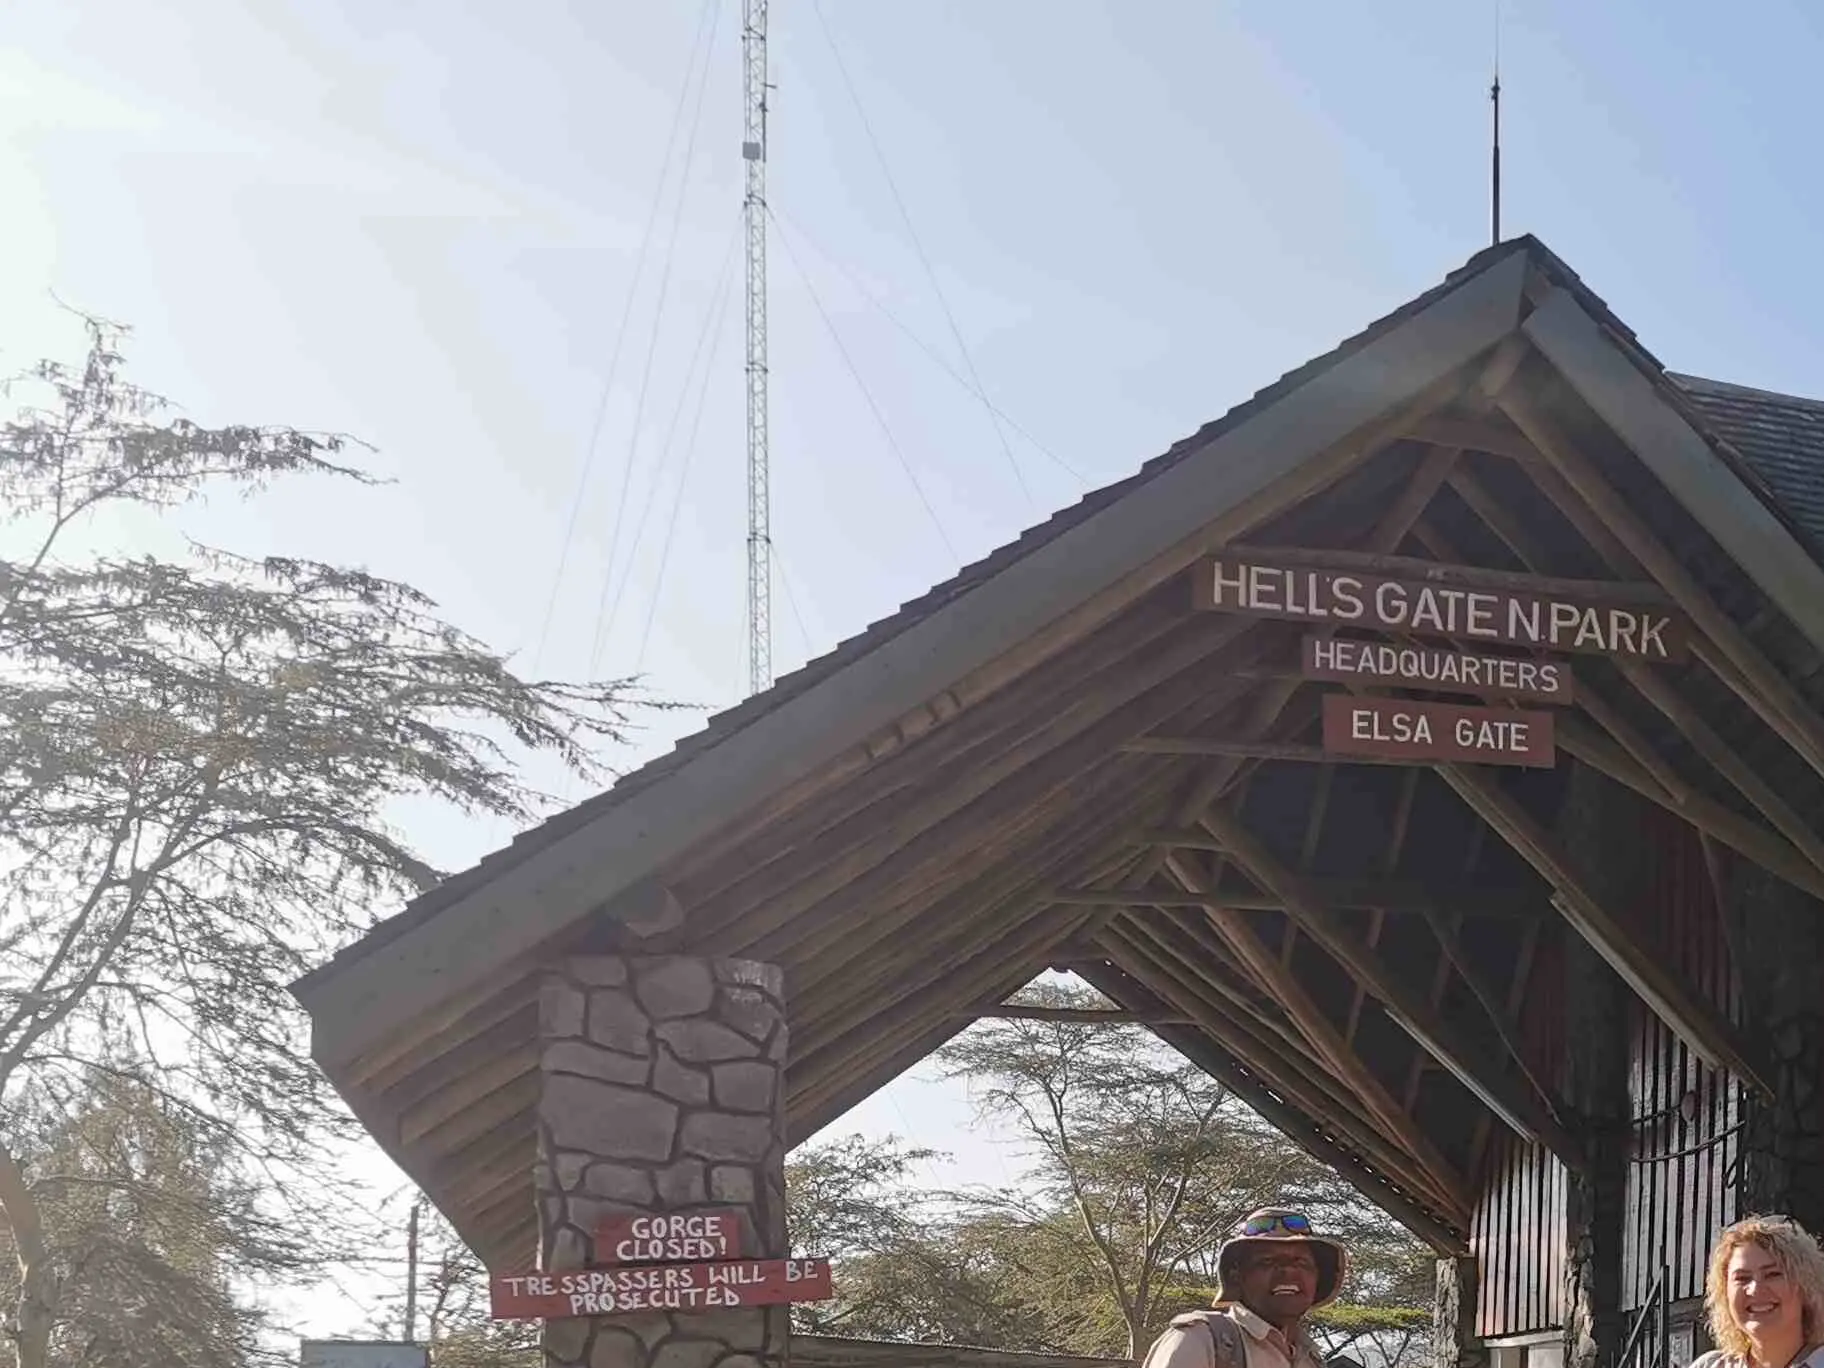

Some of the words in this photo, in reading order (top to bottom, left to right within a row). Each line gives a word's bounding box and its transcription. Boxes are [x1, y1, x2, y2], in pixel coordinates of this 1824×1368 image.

[1375, 581, 1499, 638] GATE
[1314, 640, 1560, 693] HEADQUARTERS
[1351, 709, 1433, 745] ELSA
[1454, 718, 1530, 752] GATE
[631, 1216, 722, 1238] GORGE
[616, 1236, 727, 1261] CLOSED!
[502, 1267, 695, 1297] TRESSPASSERS
[709, 1262, 766, 1285] WILL
[785, 1260, 819, 1281] BE
[571, 1288, 741, 1316] PROSECUTED
